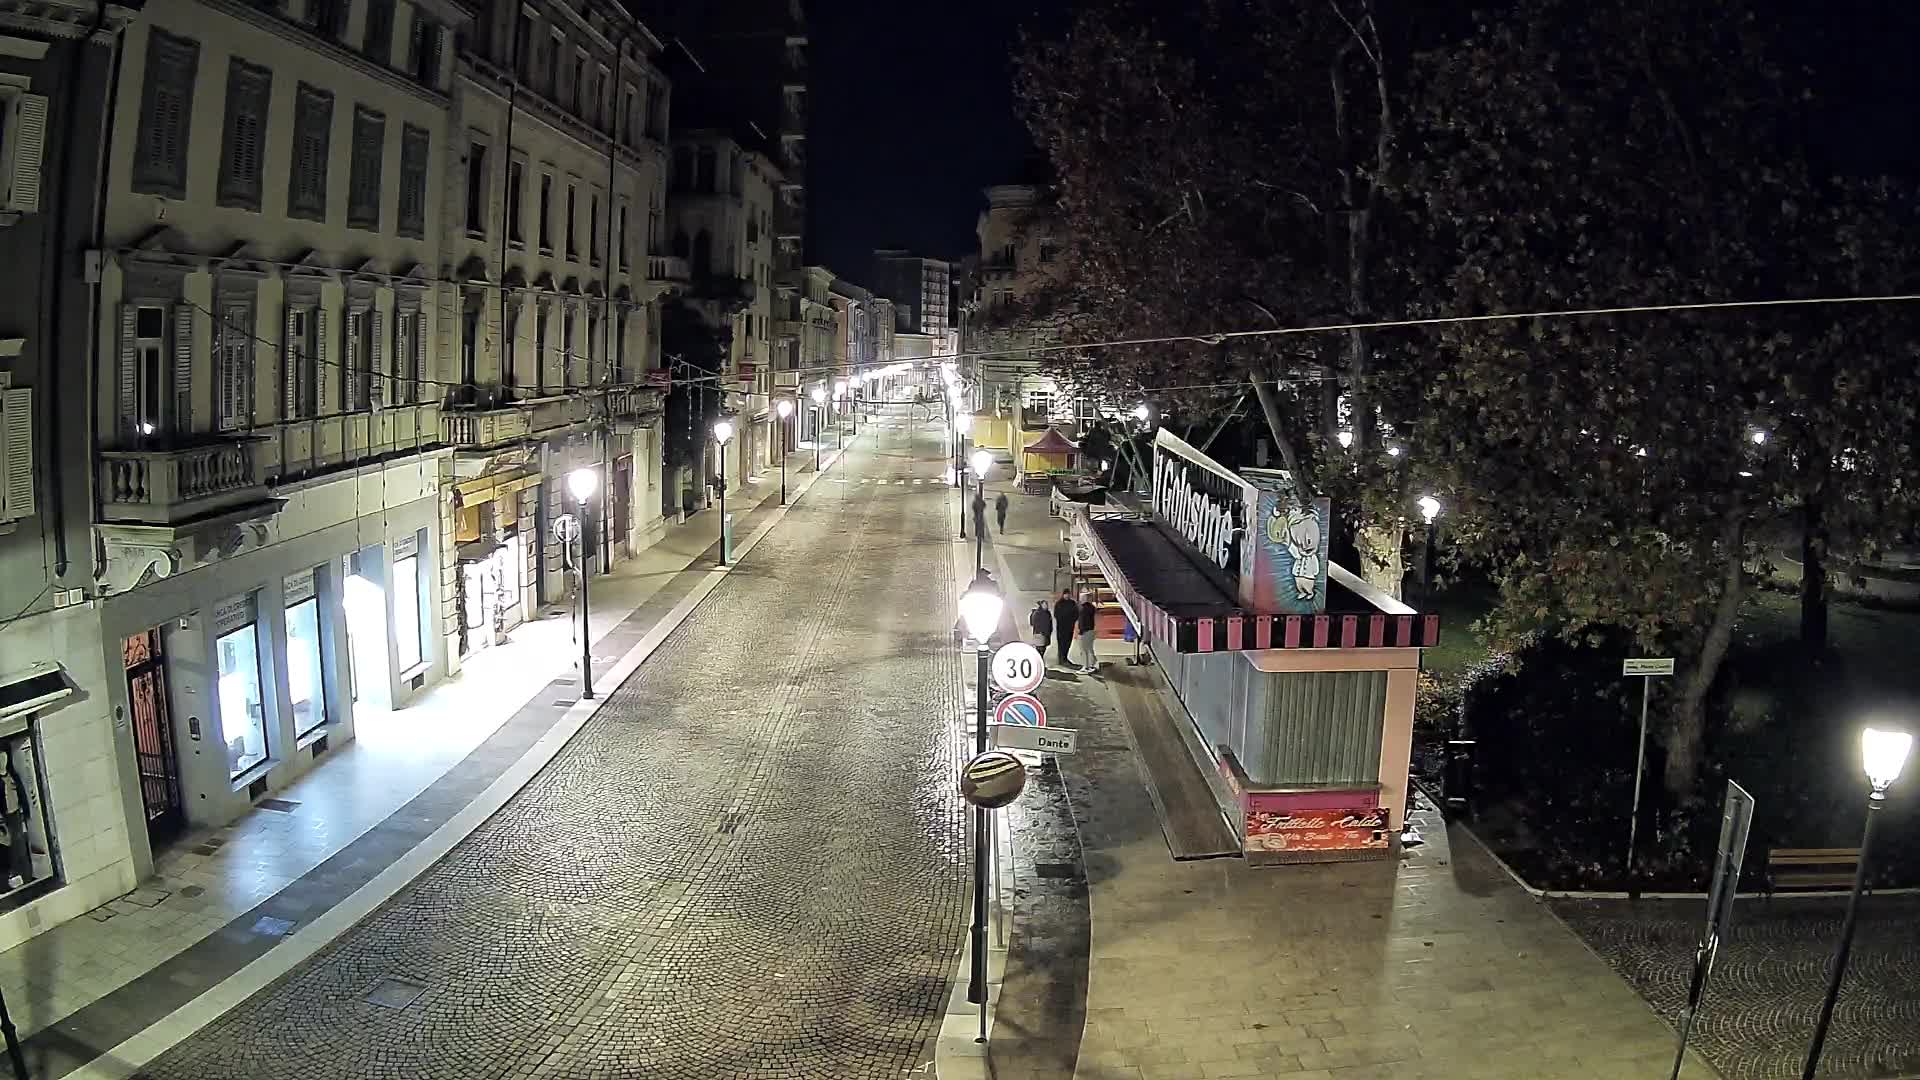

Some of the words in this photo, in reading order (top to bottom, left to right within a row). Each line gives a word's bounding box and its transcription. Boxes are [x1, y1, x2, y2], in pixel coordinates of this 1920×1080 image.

[1162, 458, 1233, 569] Golosone
[1006, 658, 1032, 679] 30
[1038, 737, 1070, 749] Dante
